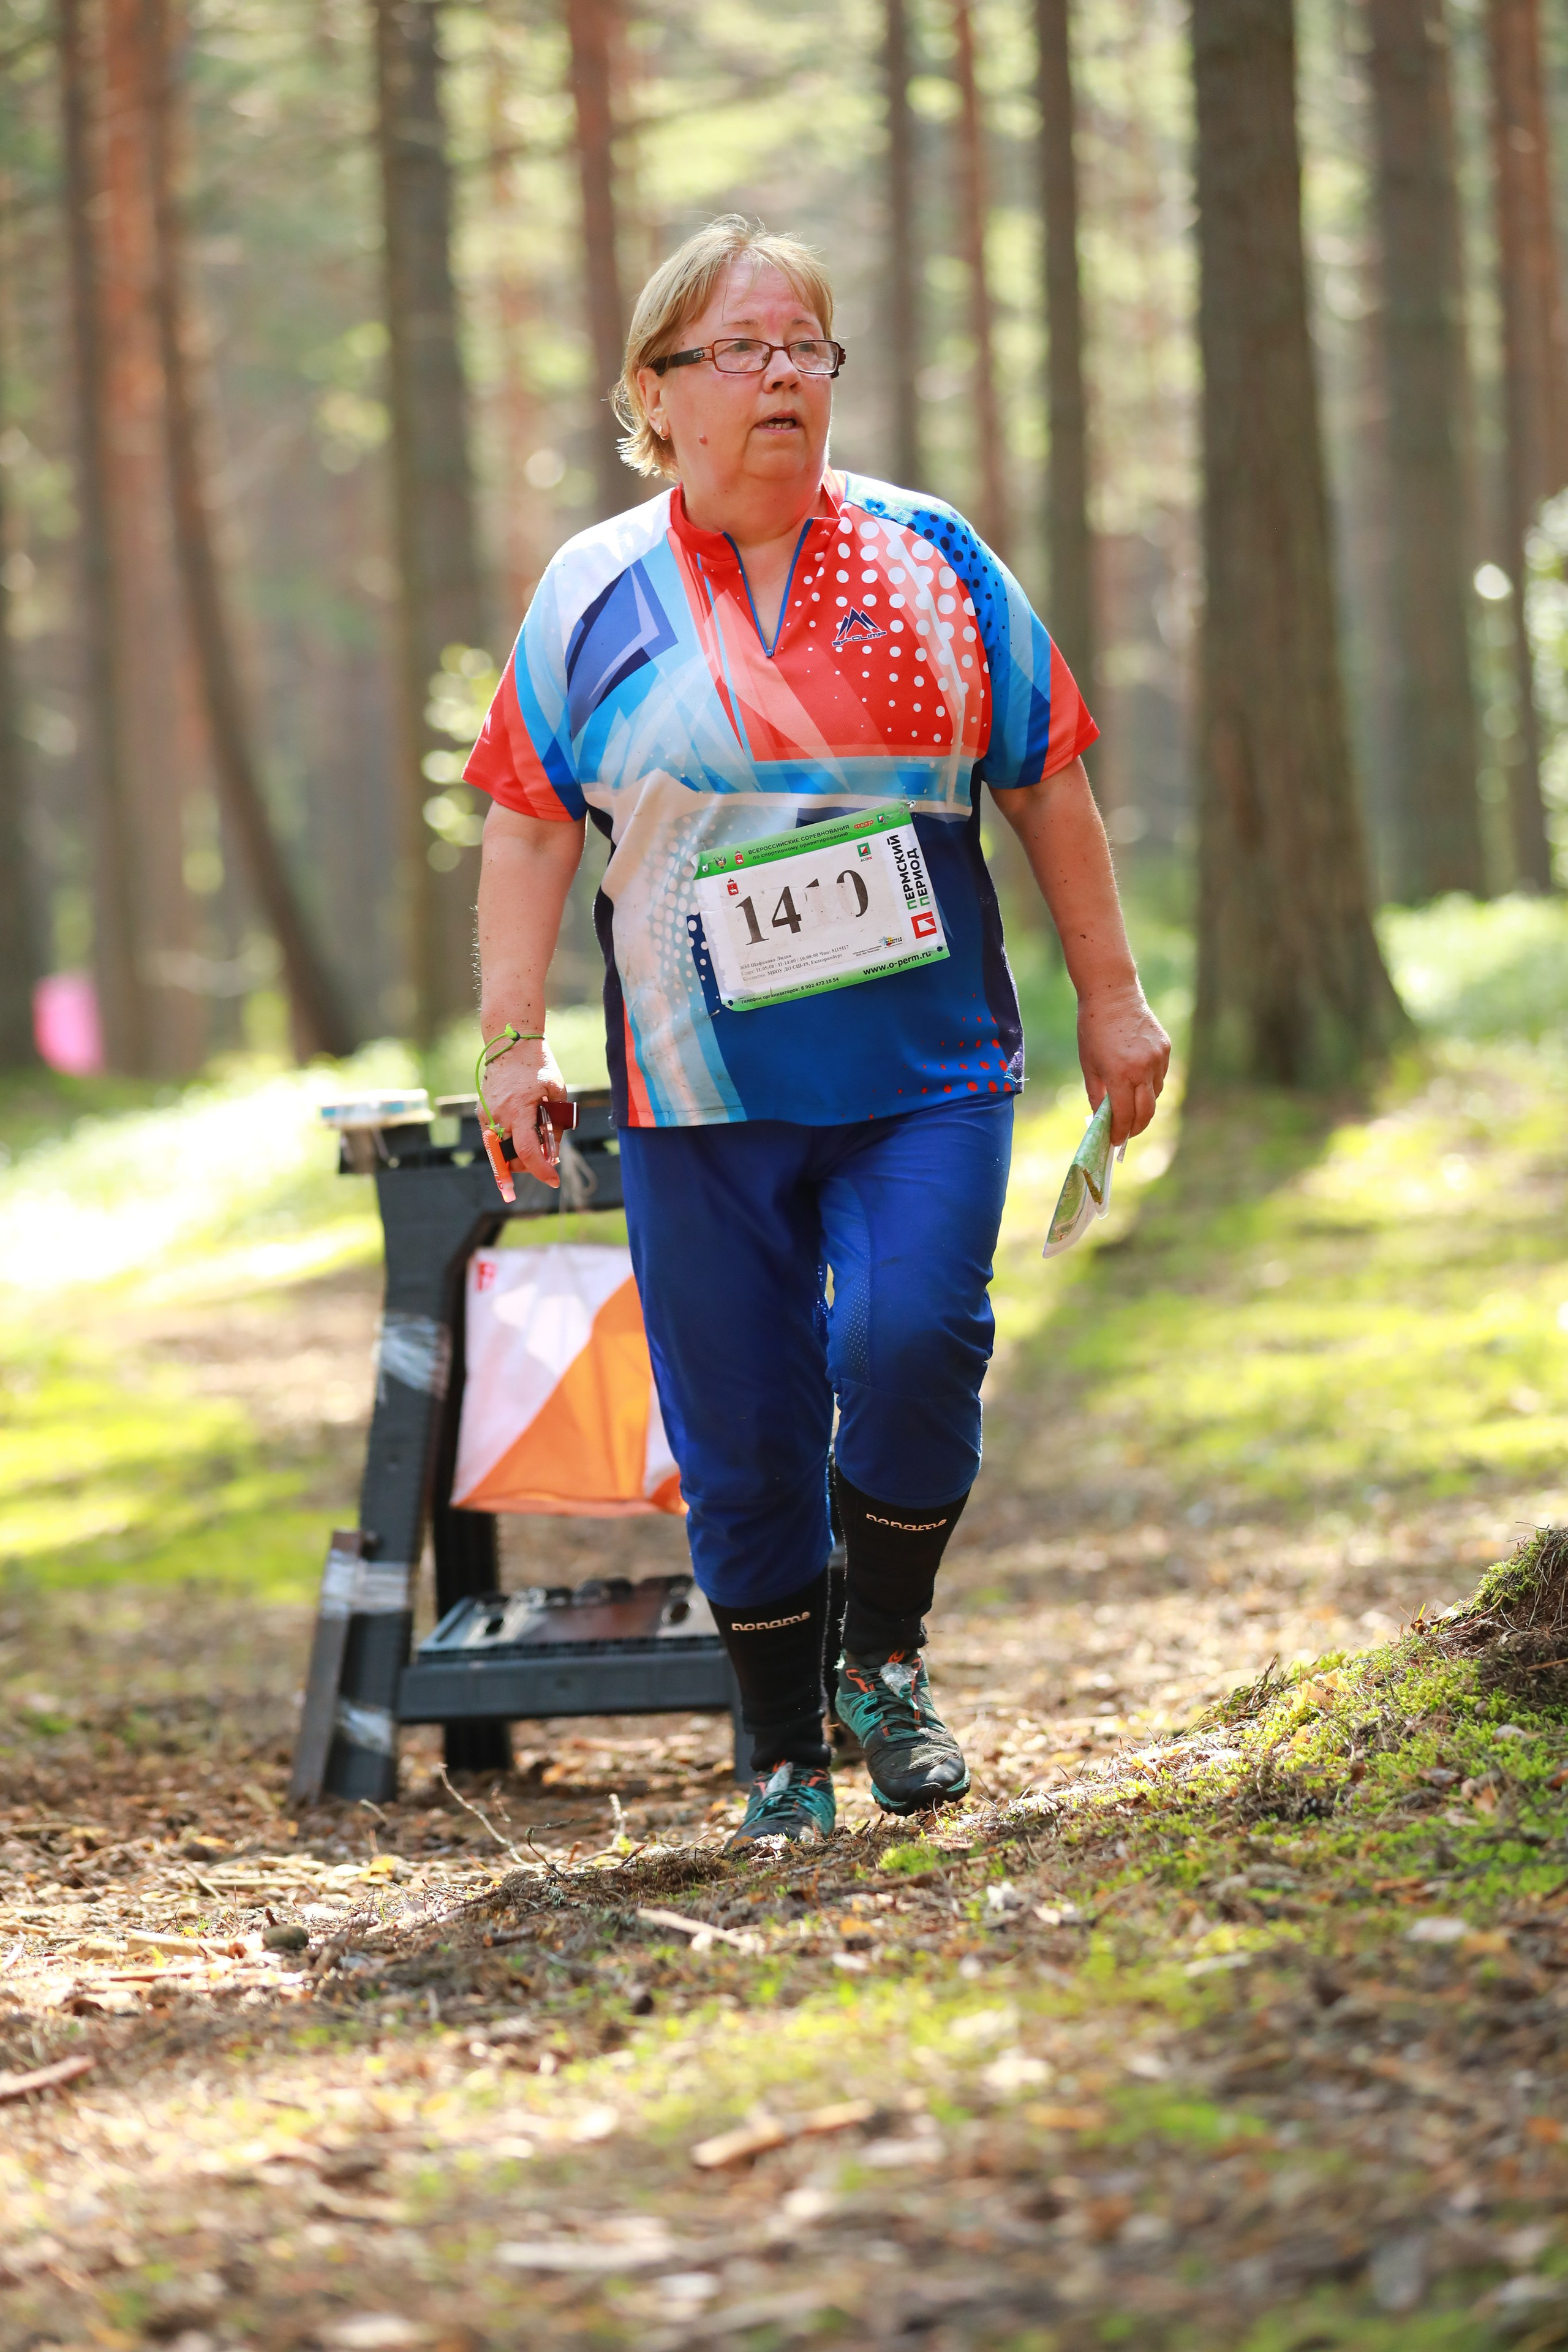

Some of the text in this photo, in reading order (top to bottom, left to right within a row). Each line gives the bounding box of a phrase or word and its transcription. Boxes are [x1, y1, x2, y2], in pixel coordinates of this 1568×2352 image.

[748, 824, 850, 855] ВСЕРОССИЙСКИЕ СОРЕВНОВАНИЯ
[761, 845, 799, 858] спортивному
[799, 832, 848, 848] ориентированию
[886, 834, 918, 910] ПЕРМСКИЙ
[907, 848, 930, 907] ПЕРИОД
[862, 951, 931, 975] www.o-perm.ru
[763, 987, 801, 1000] организаторов:
[866, 1513, 947, 1531] noname
[731, 1611, 810, 1630] noname
